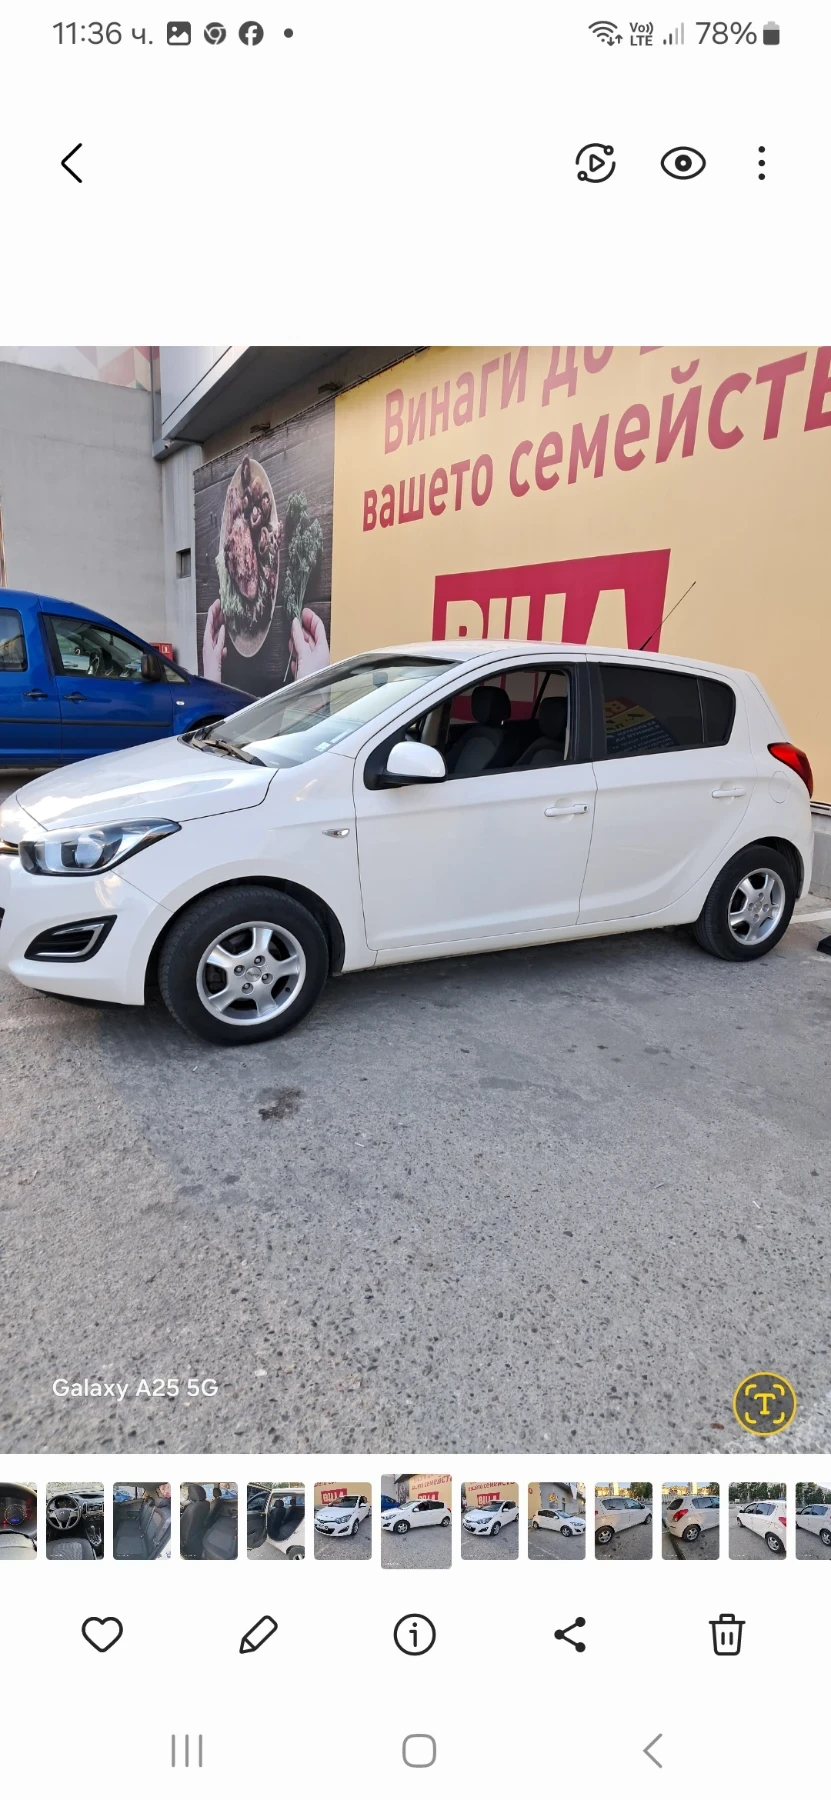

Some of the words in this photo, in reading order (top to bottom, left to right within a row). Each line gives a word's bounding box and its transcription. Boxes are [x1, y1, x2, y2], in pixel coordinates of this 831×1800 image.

[52, 21, 122, 45] 11:36
[630, 35, 653, 46] LTE
[695, 21, 757, 45] 78%
[384, 346, 529, 455] Винаги
[362, 453, 494, 532] вашето
